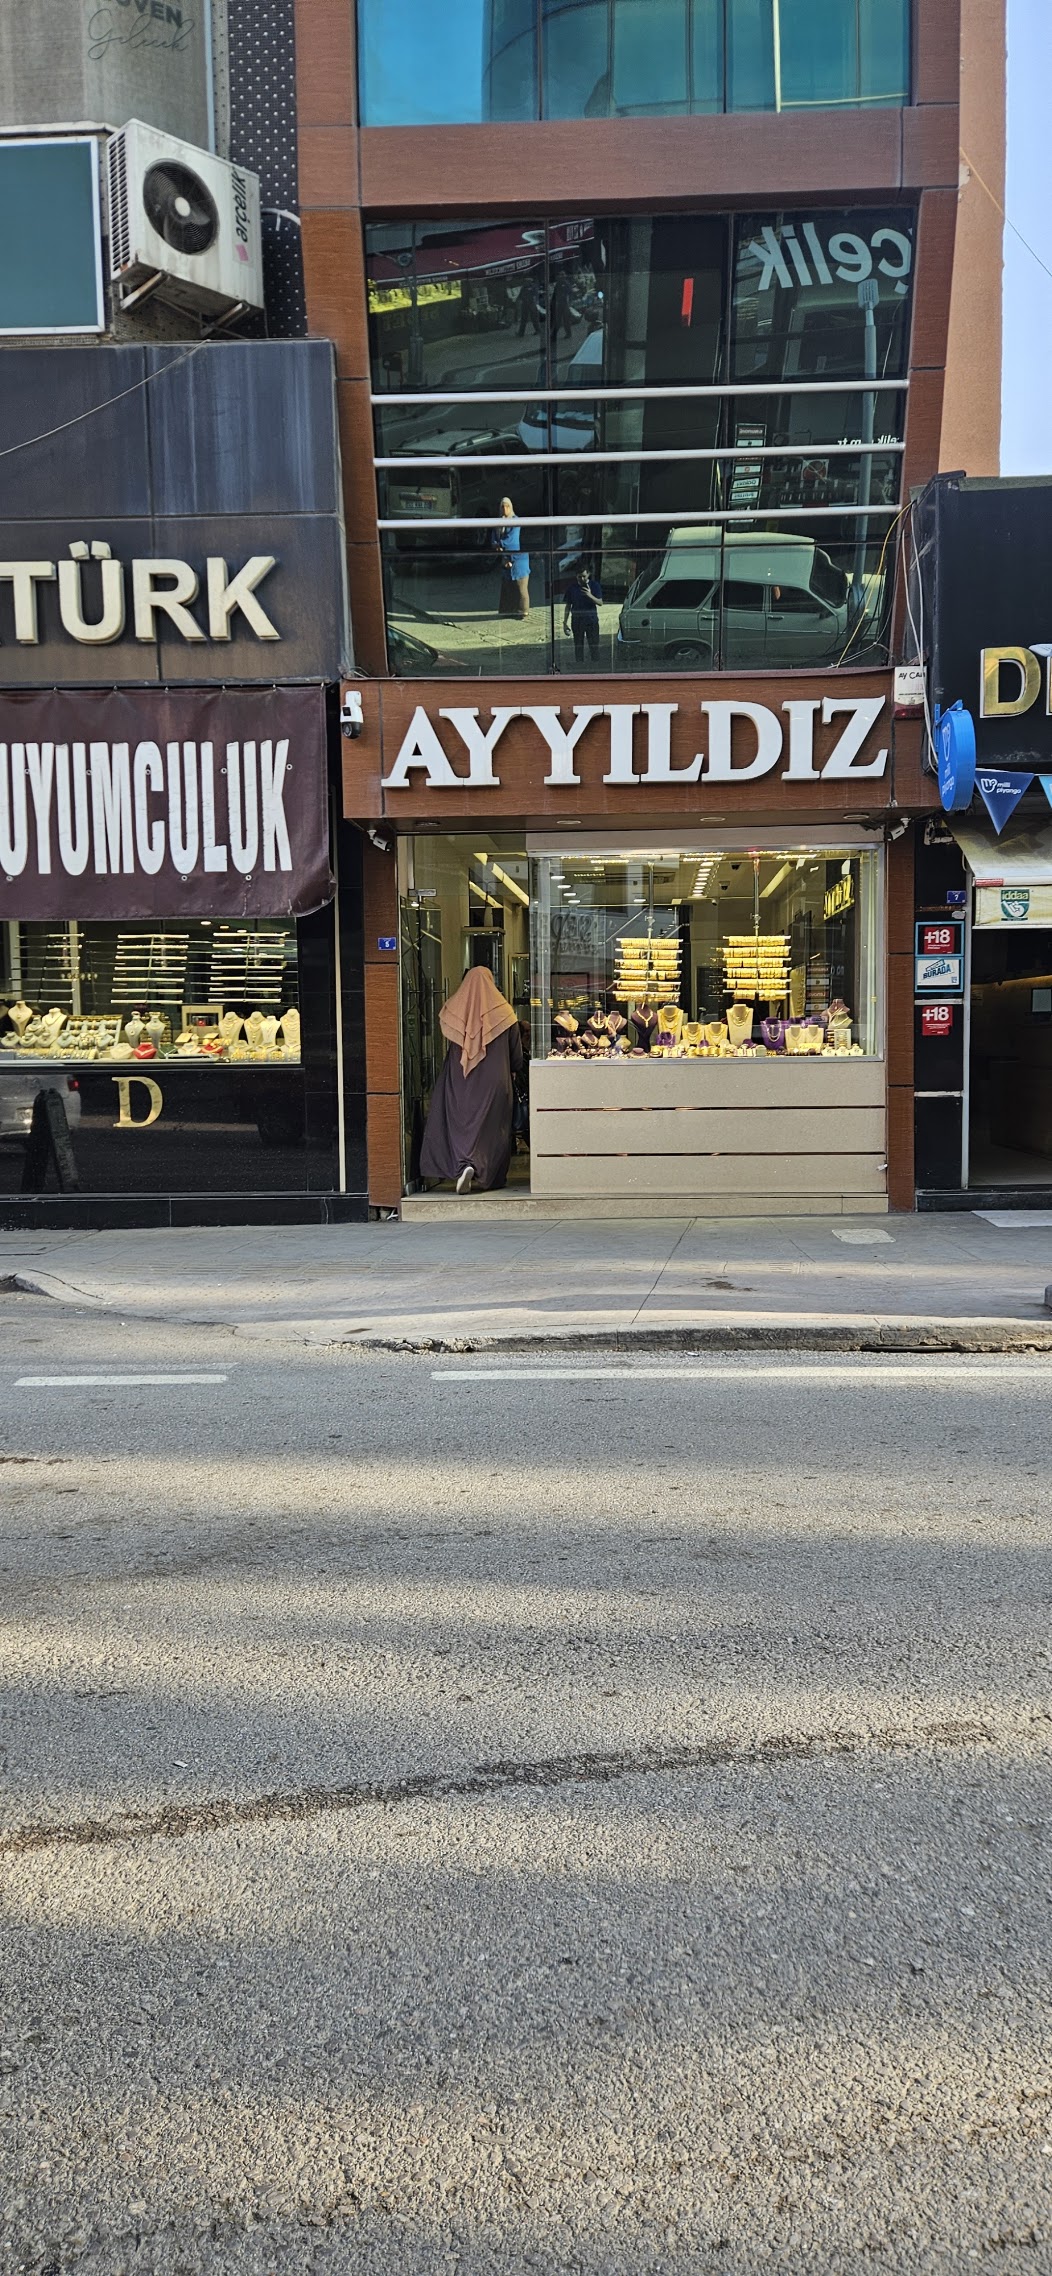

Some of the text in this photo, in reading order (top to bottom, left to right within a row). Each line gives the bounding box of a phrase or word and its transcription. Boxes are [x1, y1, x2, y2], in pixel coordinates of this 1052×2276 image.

[231, 166, 250, 243] arçelik
[0, 540, 281, 645] TÜRK
[381, 695, 888, 788] AYYILDIZ
[1001, 890, 1029, 900] iddaa
[924, 929, 950, 944] +18
[922, 1006, 950, 1021] +18
[112, 1076, 163, 1128] D
